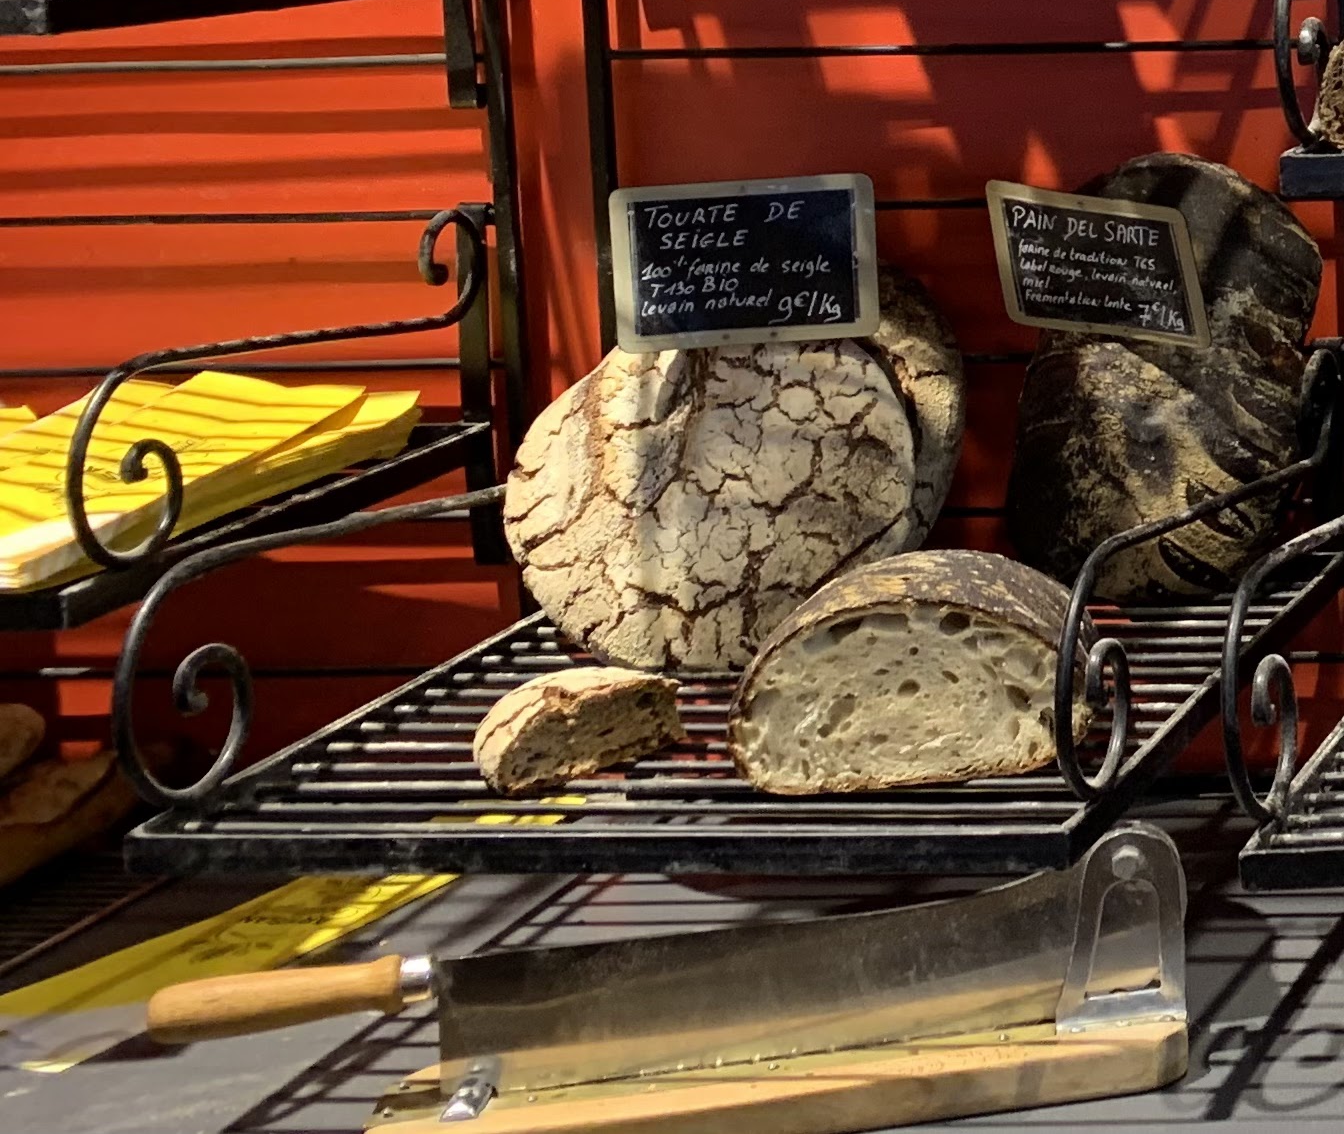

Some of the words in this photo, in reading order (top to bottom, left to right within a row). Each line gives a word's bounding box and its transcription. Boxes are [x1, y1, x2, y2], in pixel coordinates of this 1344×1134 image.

[644, 203, 739, 229] TOURTE
[764, 200, 805, 223] DE
[1011, 205, 1057, 231] PAIN
[1063, 217, 1098, 241] DEL
[1104, 220, 1160, 247] SARTE
[659, 229, 749, 250] SEIGLE
[1018, 238, 1050, 258] farine
[1053, 247, 1066, 259] de
[1070, 247, 1128, 266] tradition
[687, 258, 740, 282] farine
[750, 257, 770, 273] de
[782, 255, 831, 279] seigle
[650, 282, 694, 298] T130
[701, 277, 739, 293] BIO
[705, 288, 773, 310] naturel
